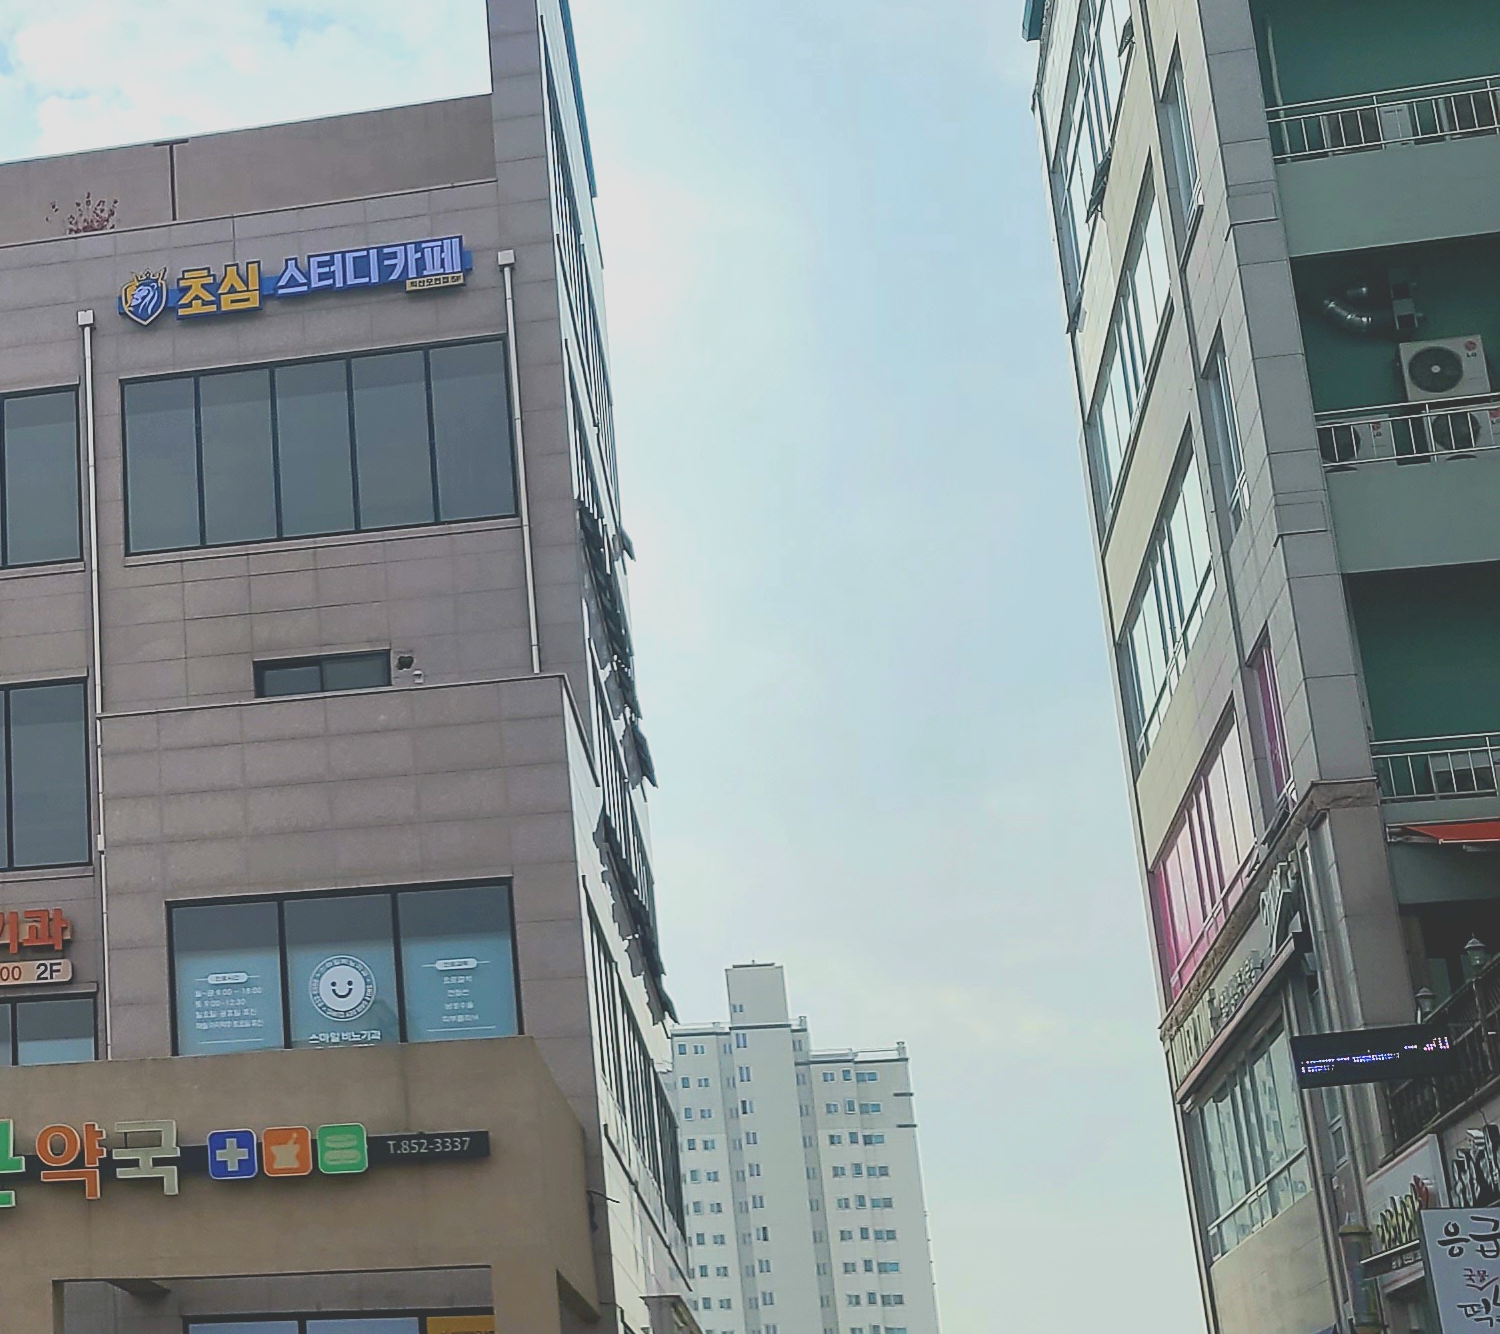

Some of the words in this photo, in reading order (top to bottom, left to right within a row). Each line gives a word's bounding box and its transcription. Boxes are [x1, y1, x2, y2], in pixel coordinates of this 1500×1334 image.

[178, 262, 260, 316] 초심
[277, 237, 462, 294] 스터디카페
[36, 962, 62, 981] 2F
[386, 1137, 471, 1154] T.852-3337
